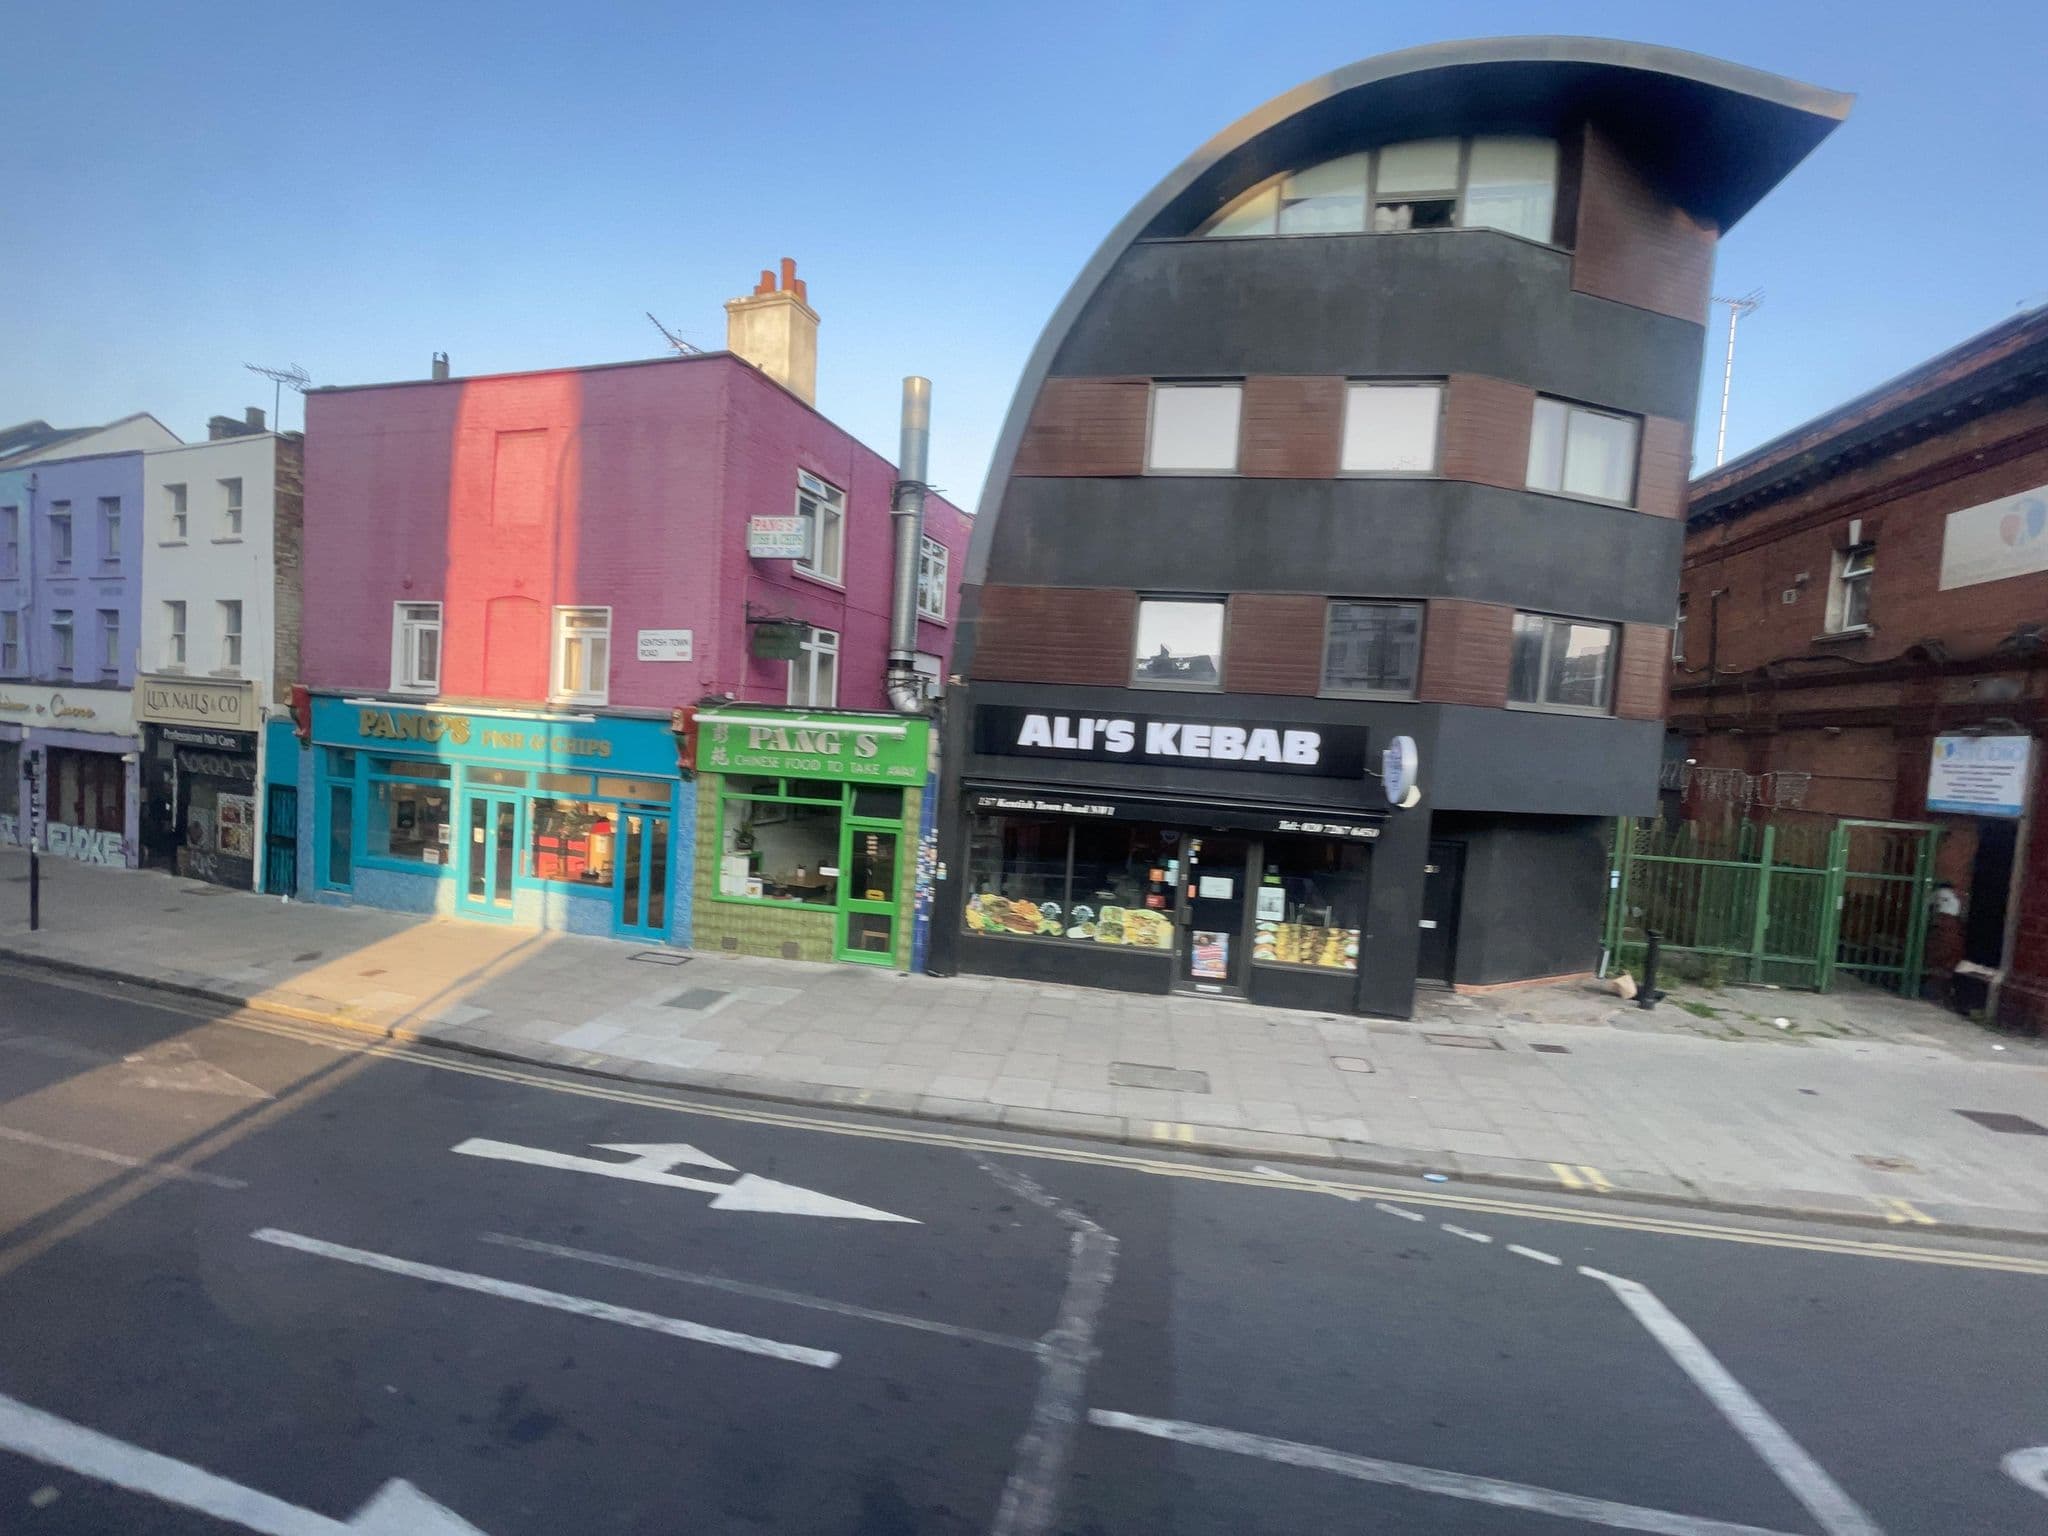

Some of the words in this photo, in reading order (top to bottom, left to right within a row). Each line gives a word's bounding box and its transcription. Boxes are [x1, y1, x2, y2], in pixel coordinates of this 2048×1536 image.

[147, 689, 170, 710] LUX
[172, 691, 209, 715] NAILS
[219, 695, 239, 713] CO
[359, 710, 470, 744] PANG'S
[1017, 714, 1136, 753] ALI'S
[1145, 722, 1321, 765] KEBAB
[219, 735, 238, 748] Care
[482, 730, 525, 749] FISH
[550, 736, 611, 757] CHIPS
[735, 754, 780, 769] CHINESE
[785, 758, 821, 772] FOOD
[827, 760, 844, 773] TO
[850, 762, 881, 776] TAKE
[997, 798, 1035, 809] Kentish
[1036, 801, 1062, 811] Town
[1062, 803, 1089, 814] Road
